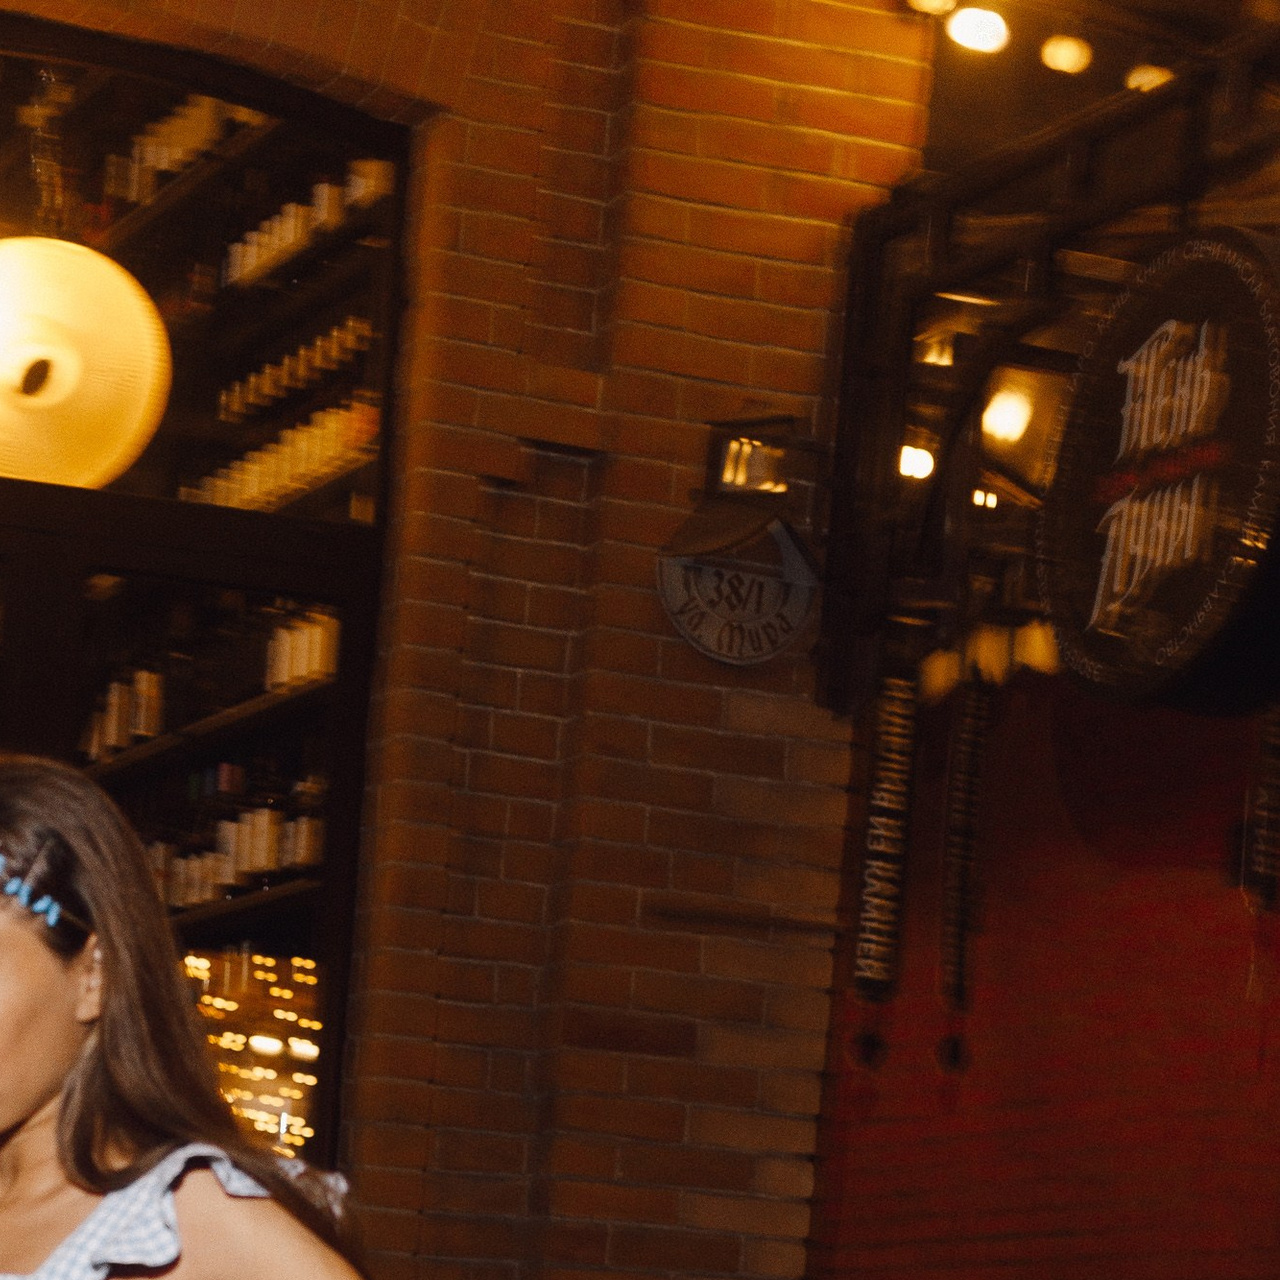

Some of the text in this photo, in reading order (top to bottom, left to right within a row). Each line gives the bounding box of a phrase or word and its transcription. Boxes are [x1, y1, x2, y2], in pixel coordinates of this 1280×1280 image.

[1225, 250, 1262, 297] МАСЛА
[1260, 300, 1280, 446] БЛАГОВОНИЯ
[866, 815, 907, 855] ИЗ
